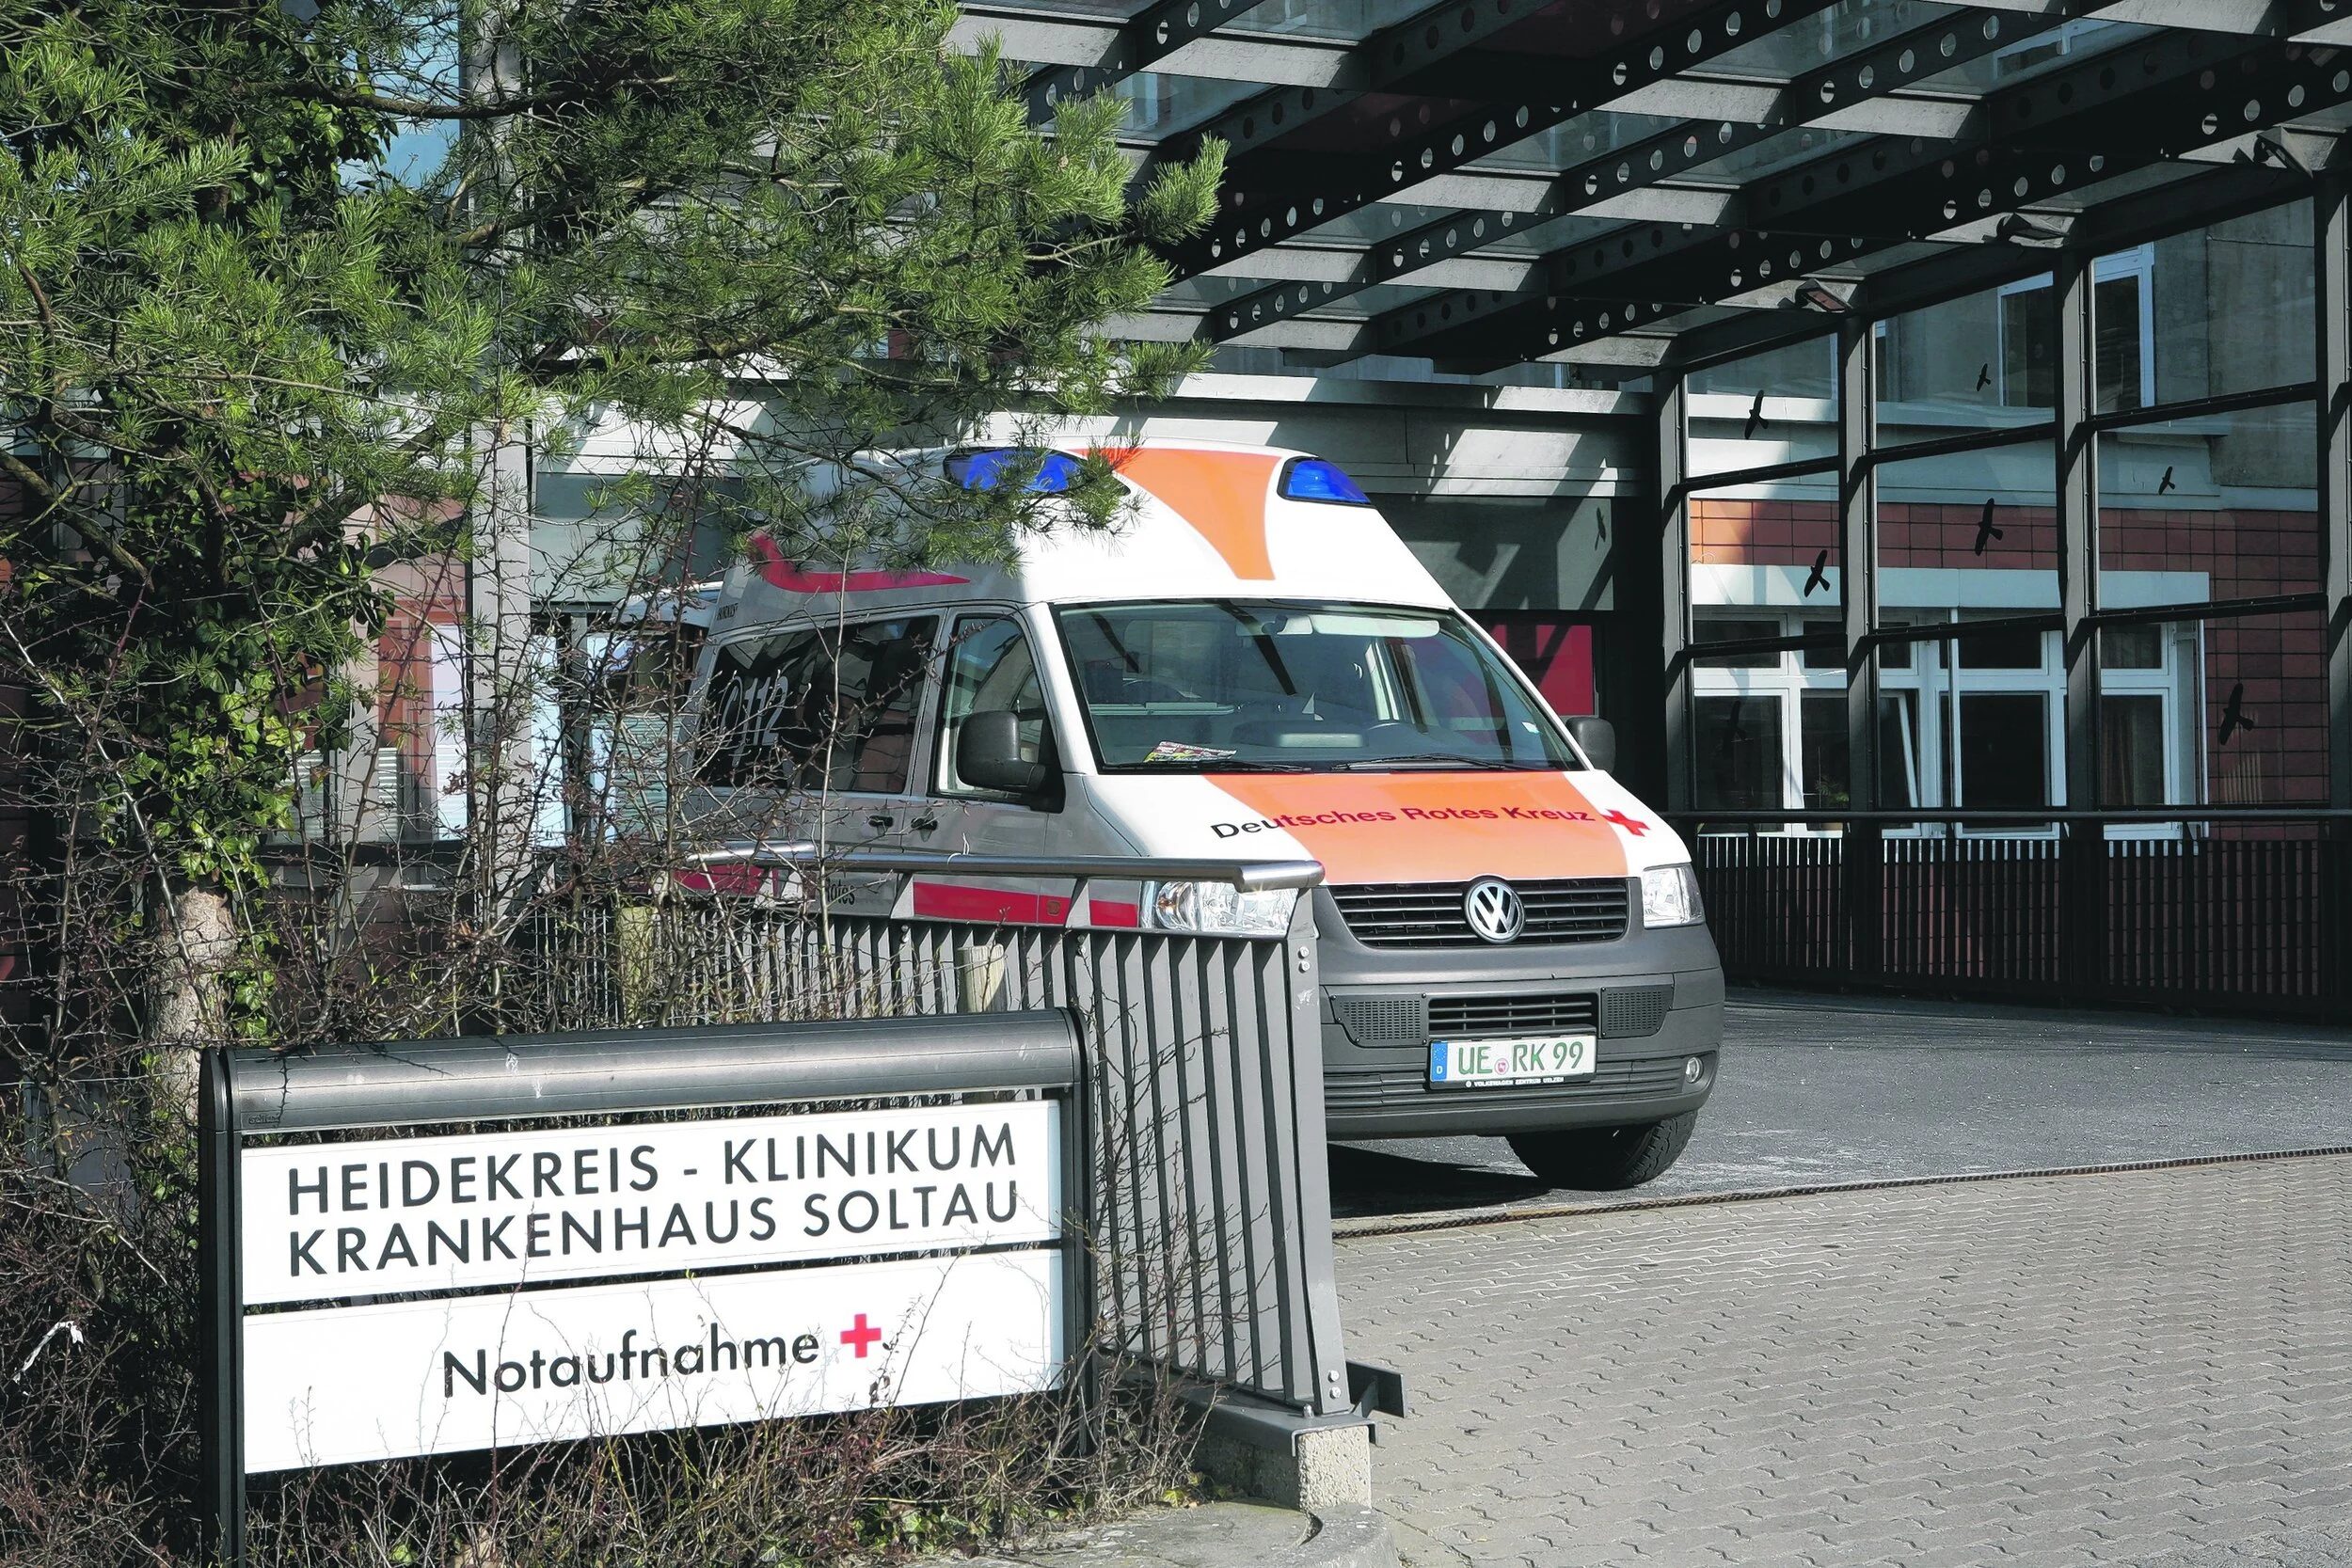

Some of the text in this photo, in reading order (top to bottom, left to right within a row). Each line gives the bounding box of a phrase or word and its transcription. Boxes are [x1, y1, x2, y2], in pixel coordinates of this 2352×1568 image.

[1210, 806, 1596, 838] Deutsches Rotes Kreuz
[1436, 1065, 1443, 1074] D
[1459, 1041, 1583, 1074] UE RK 99
[288, 1145, 660, 1215] HEIDEKREIS
[723, 1123, 1016, 1185] KLINIKUM
[289, 1180, 1018, 1277] KRANKENHAUS SOLTAU
[443, 1323, 819, 1398] Notaufnahme
